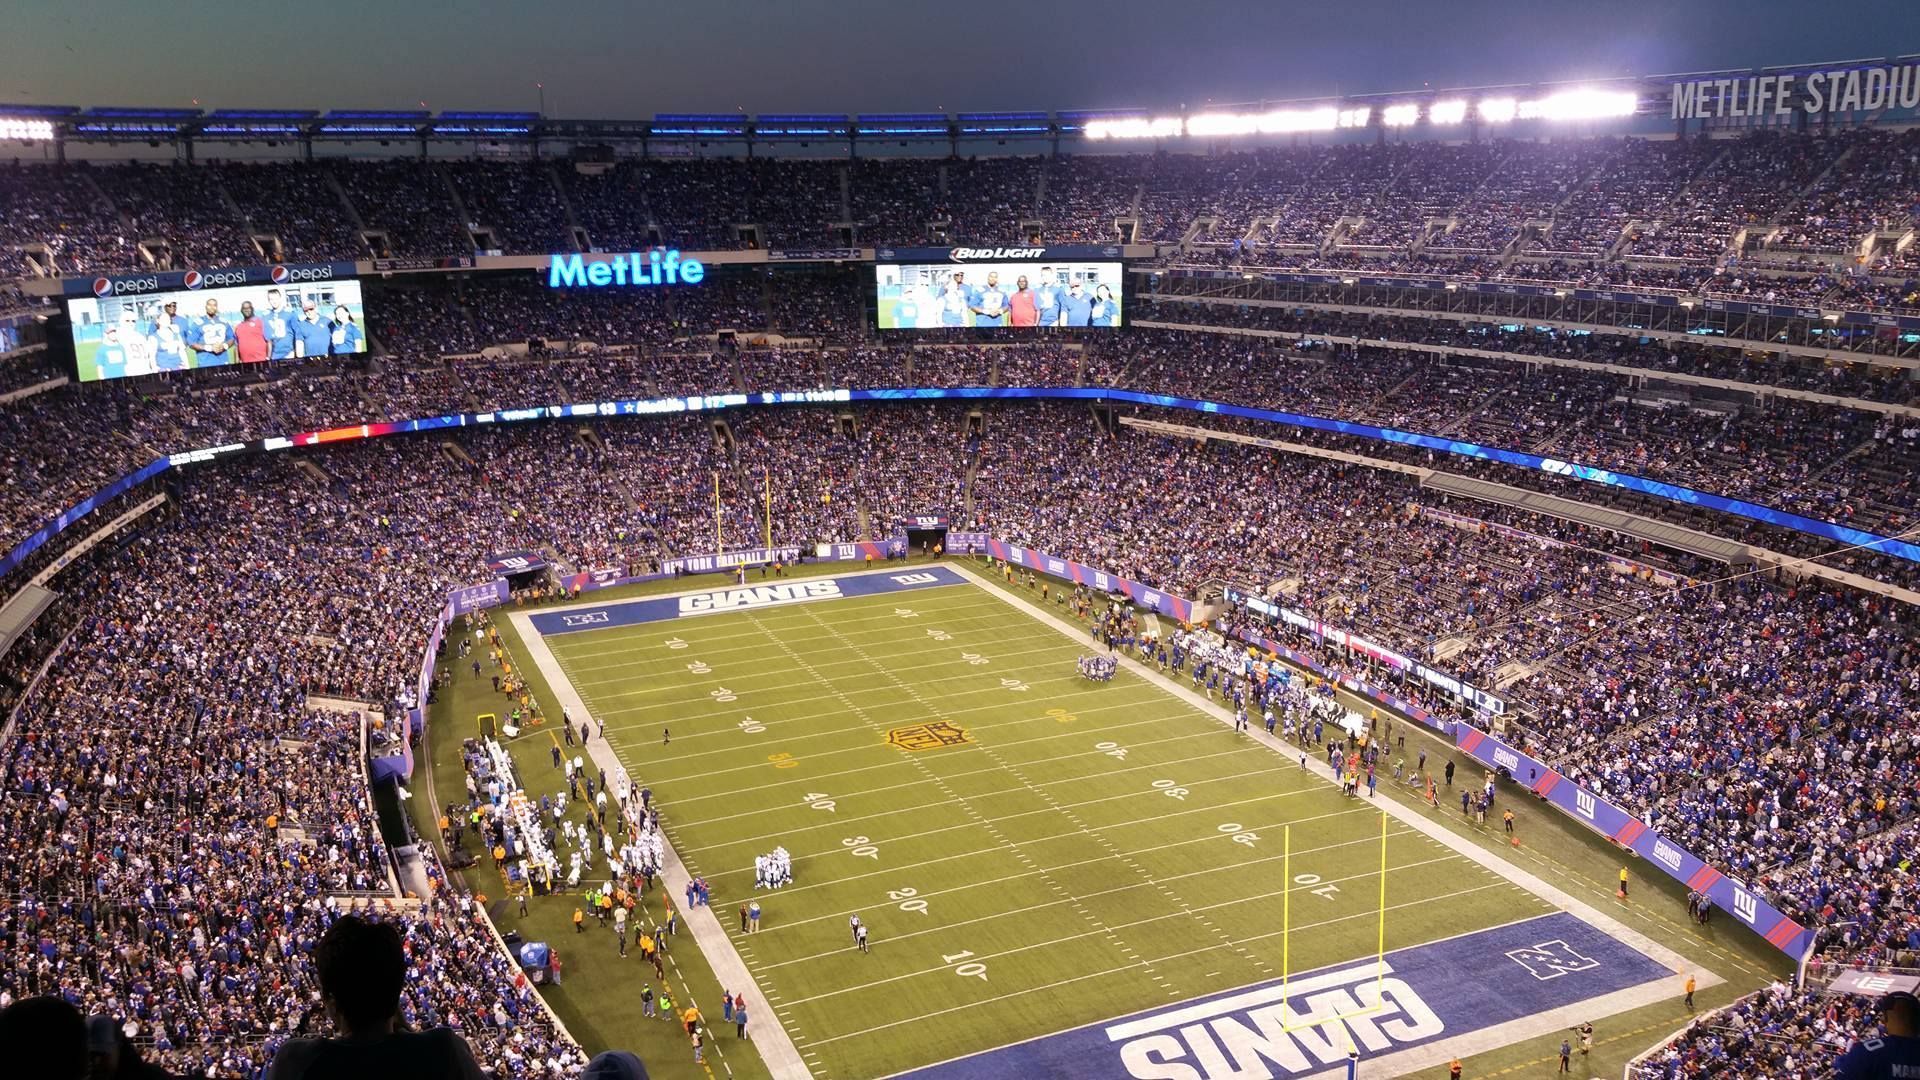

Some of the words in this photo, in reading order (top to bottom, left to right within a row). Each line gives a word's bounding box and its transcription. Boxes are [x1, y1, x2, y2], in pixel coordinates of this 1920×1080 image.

[1671, 75, 1795, 119] METLIFE
[956, 247, 995, 259] BUD
[994, 247, 1046, 259] LIGHT
[203, 269, 247, 287] pepsi
[290, 265, 333, 282] pepsi
[550, 250, 704, 287] MetLife
[114, 275, 158, 295] pepsi
[663, 558, 684, 575] NEW
[687, 556, 713, 572] YORK
[679, 579, 842, 613] GIANTS
[665, 638, 689, 650] 10
[688, 661, 712, 674] 20
[962, 653, 990, 665] 30
[1001, 679, 1030, 691] 40
[711, 688, 738, 702] 30
[738, 718, 767, 734] 40
[1095, 741, 1129, 758] 40
[1493, 747, 1519, 769] GIANTS
[767, 752, 799, 769] 50
[1151, 779, 1190, 798] 30
[803, 792, 837, 811] 40
[1217, 823, 1262, 846] 20
[842, 836, 879, 857] 30
[1653, 840, 1683, 869] GIANTS
[1293, 874, 1341, 899] 10
[886, 887, 929, 912] 20
[942, 949, 988, 977] 10
[1119, 976, 1445, 1080] GIANTS
